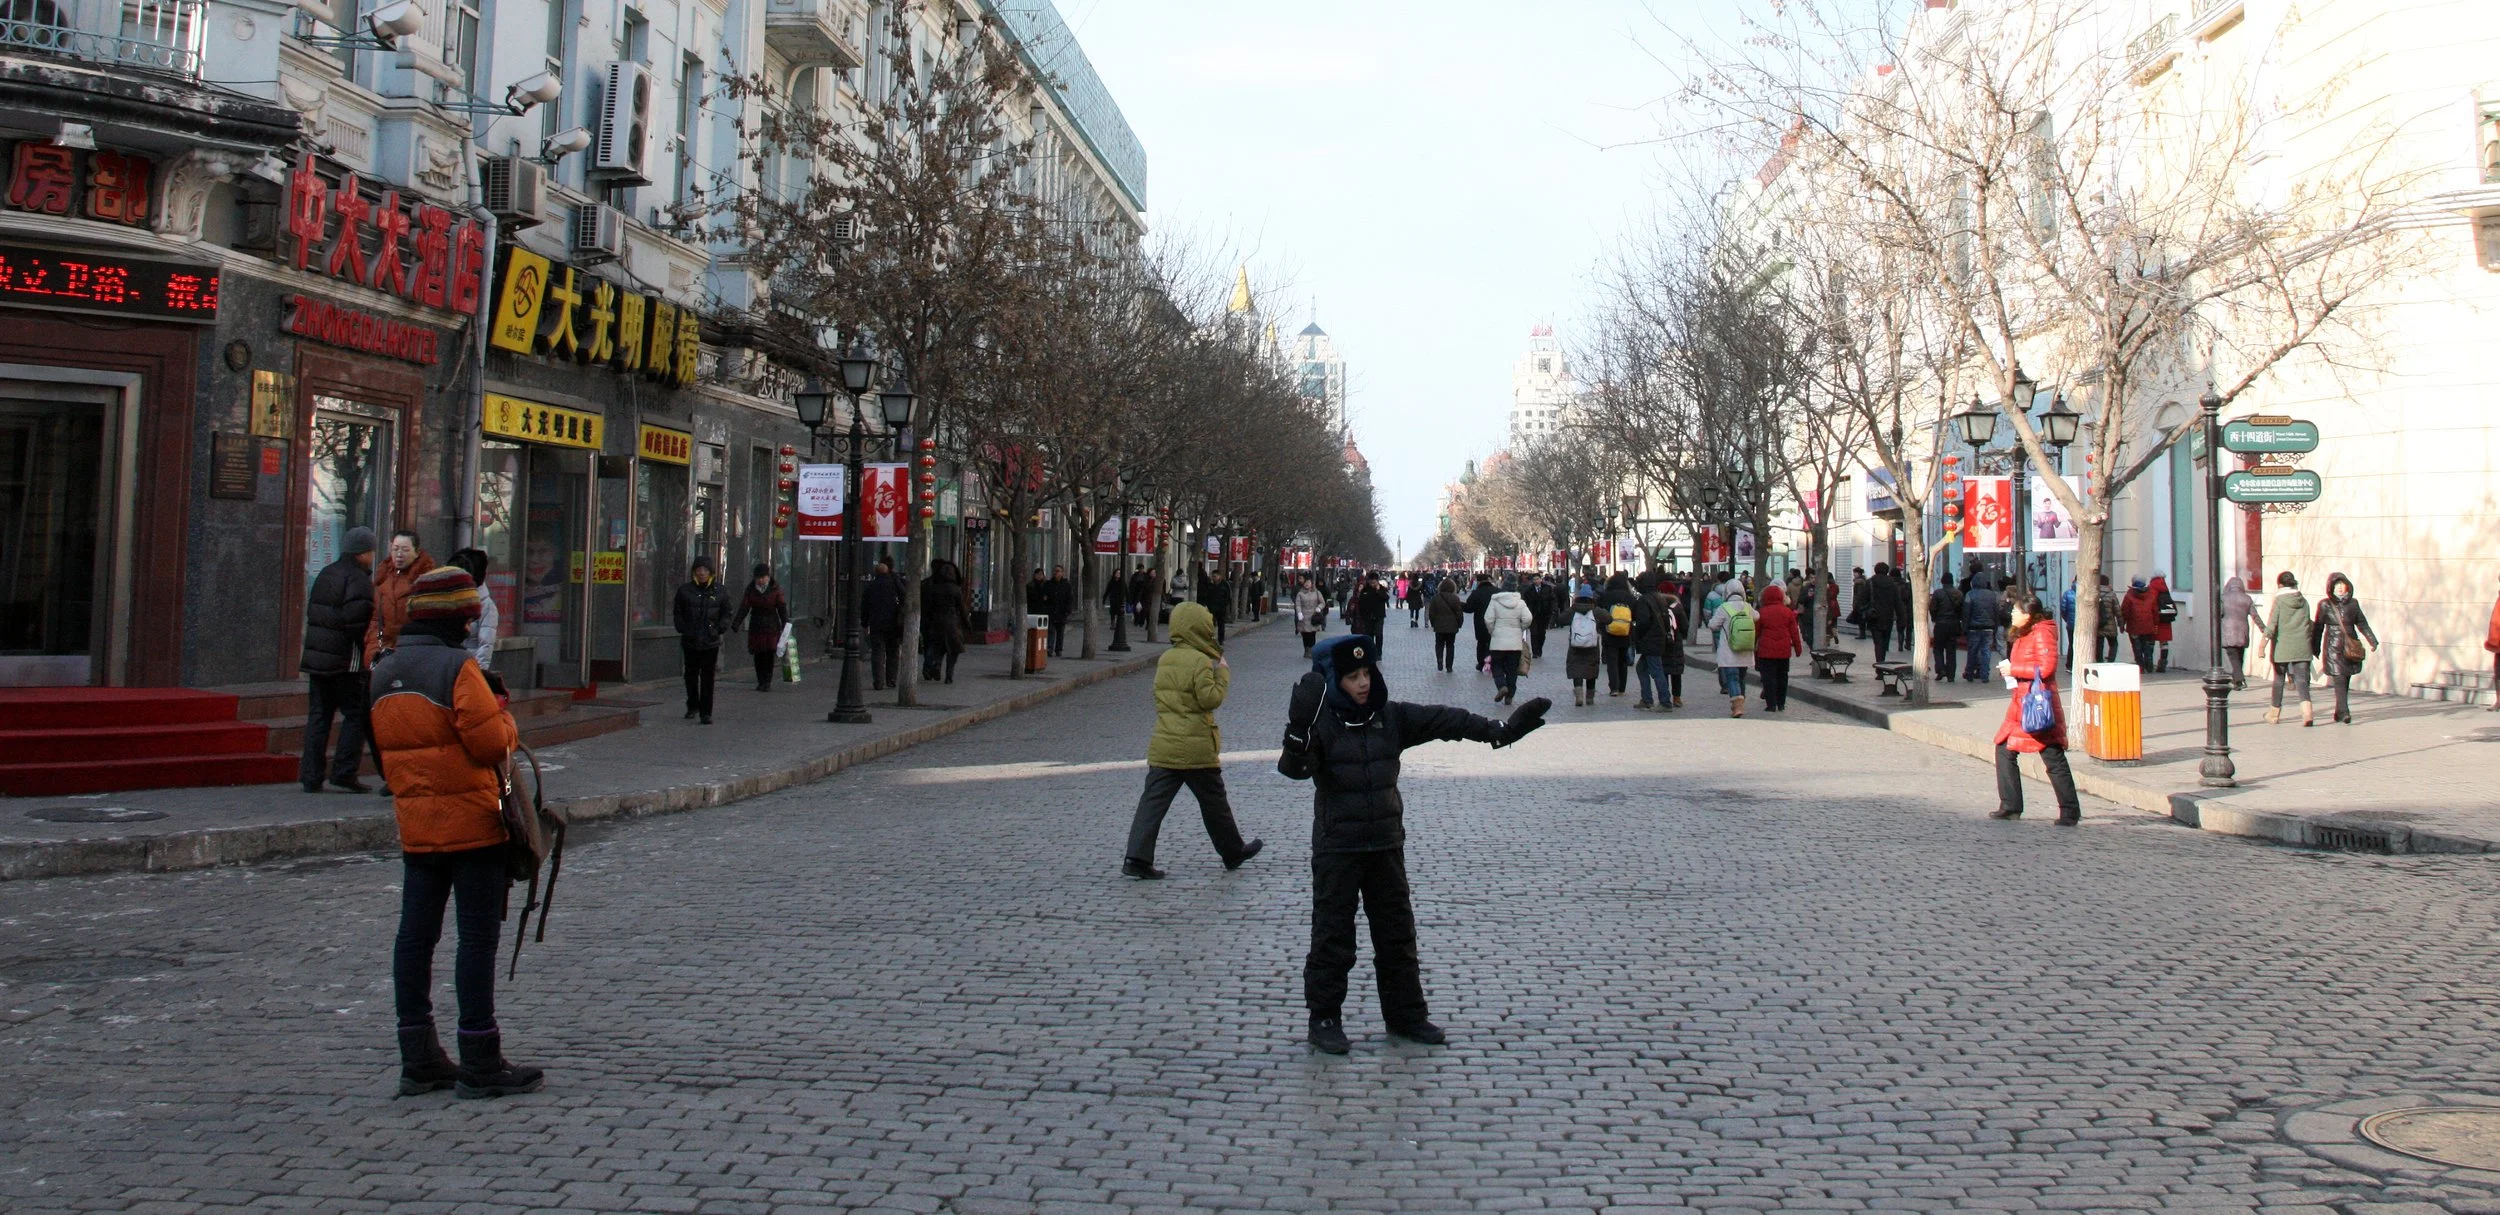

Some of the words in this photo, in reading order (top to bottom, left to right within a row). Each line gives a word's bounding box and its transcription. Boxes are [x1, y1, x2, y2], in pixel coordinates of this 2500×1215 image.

[5, 140, 152, 224] 房部
[289, 153, 485, 316] 中大大酒店
[290, 295, 385, 352] ZHONGDA
[385, 321, 440, 365] HOTEL
[546, 266, 701, 385] 大光明眼镜
[2229, 430, 2273, 443] 西十四道街
[874, 487, 897, 509] 福
[1976, 499, 2000, 521] 福
[571, 567, 624, 582] 专修表
